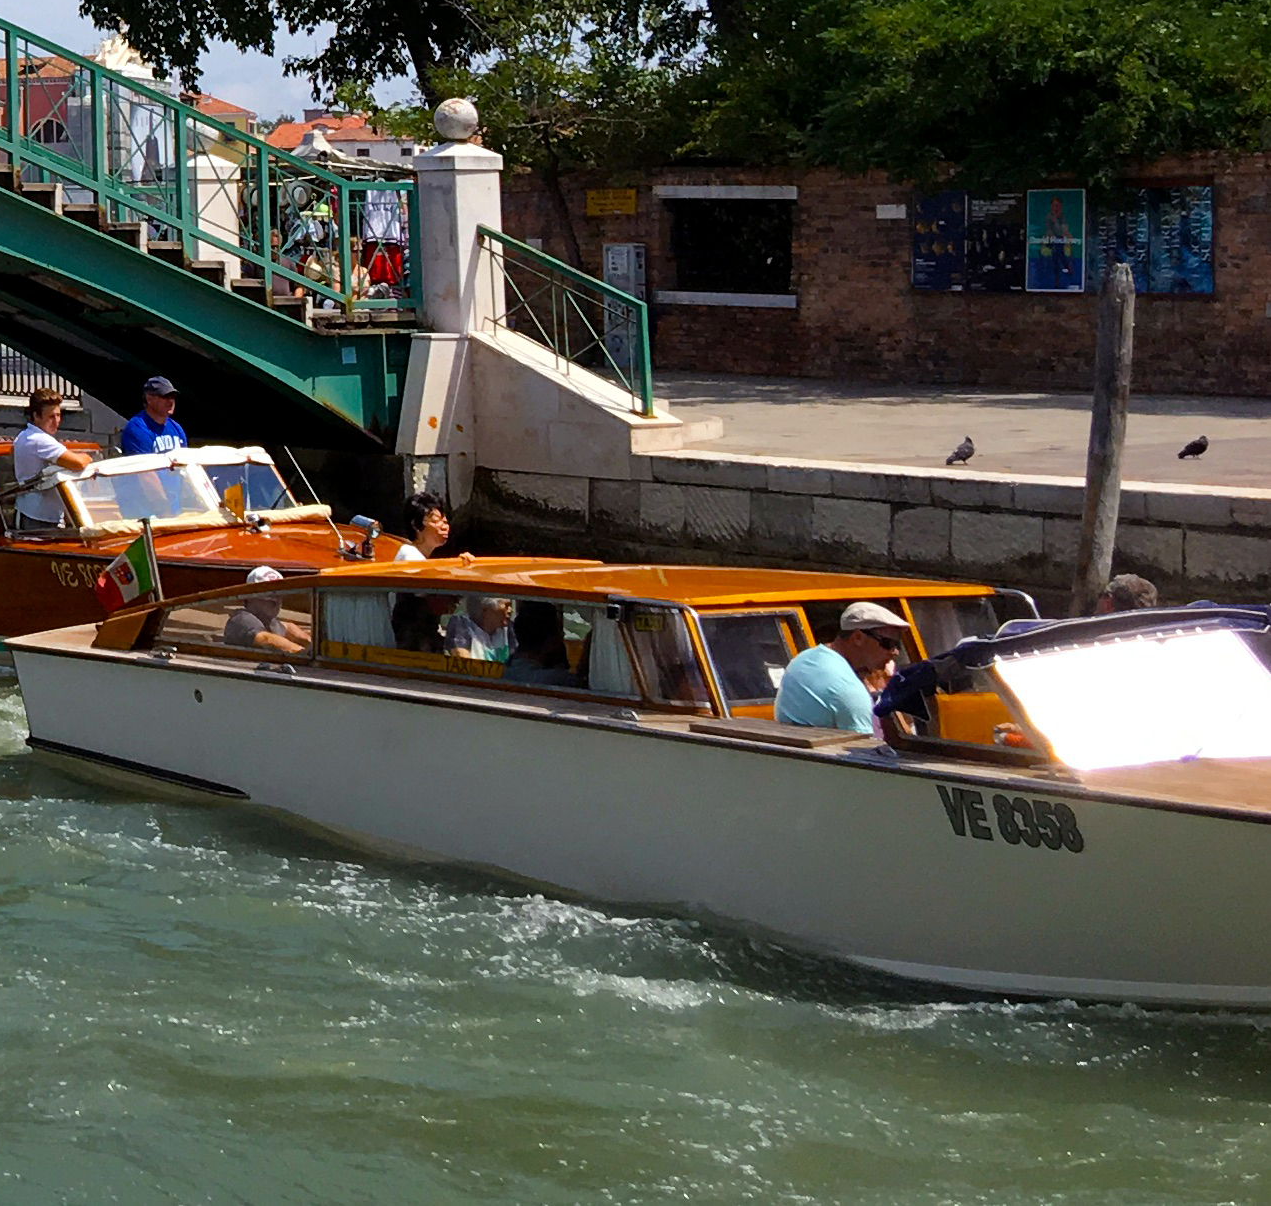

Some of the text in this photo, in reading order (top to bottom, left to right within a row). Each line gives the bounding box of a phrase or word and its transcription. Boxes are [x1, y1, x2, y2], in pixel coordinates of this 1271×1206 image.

[444, 654, 473, 675] TAXI
[936, 785, 1085, 854] VE 8358
